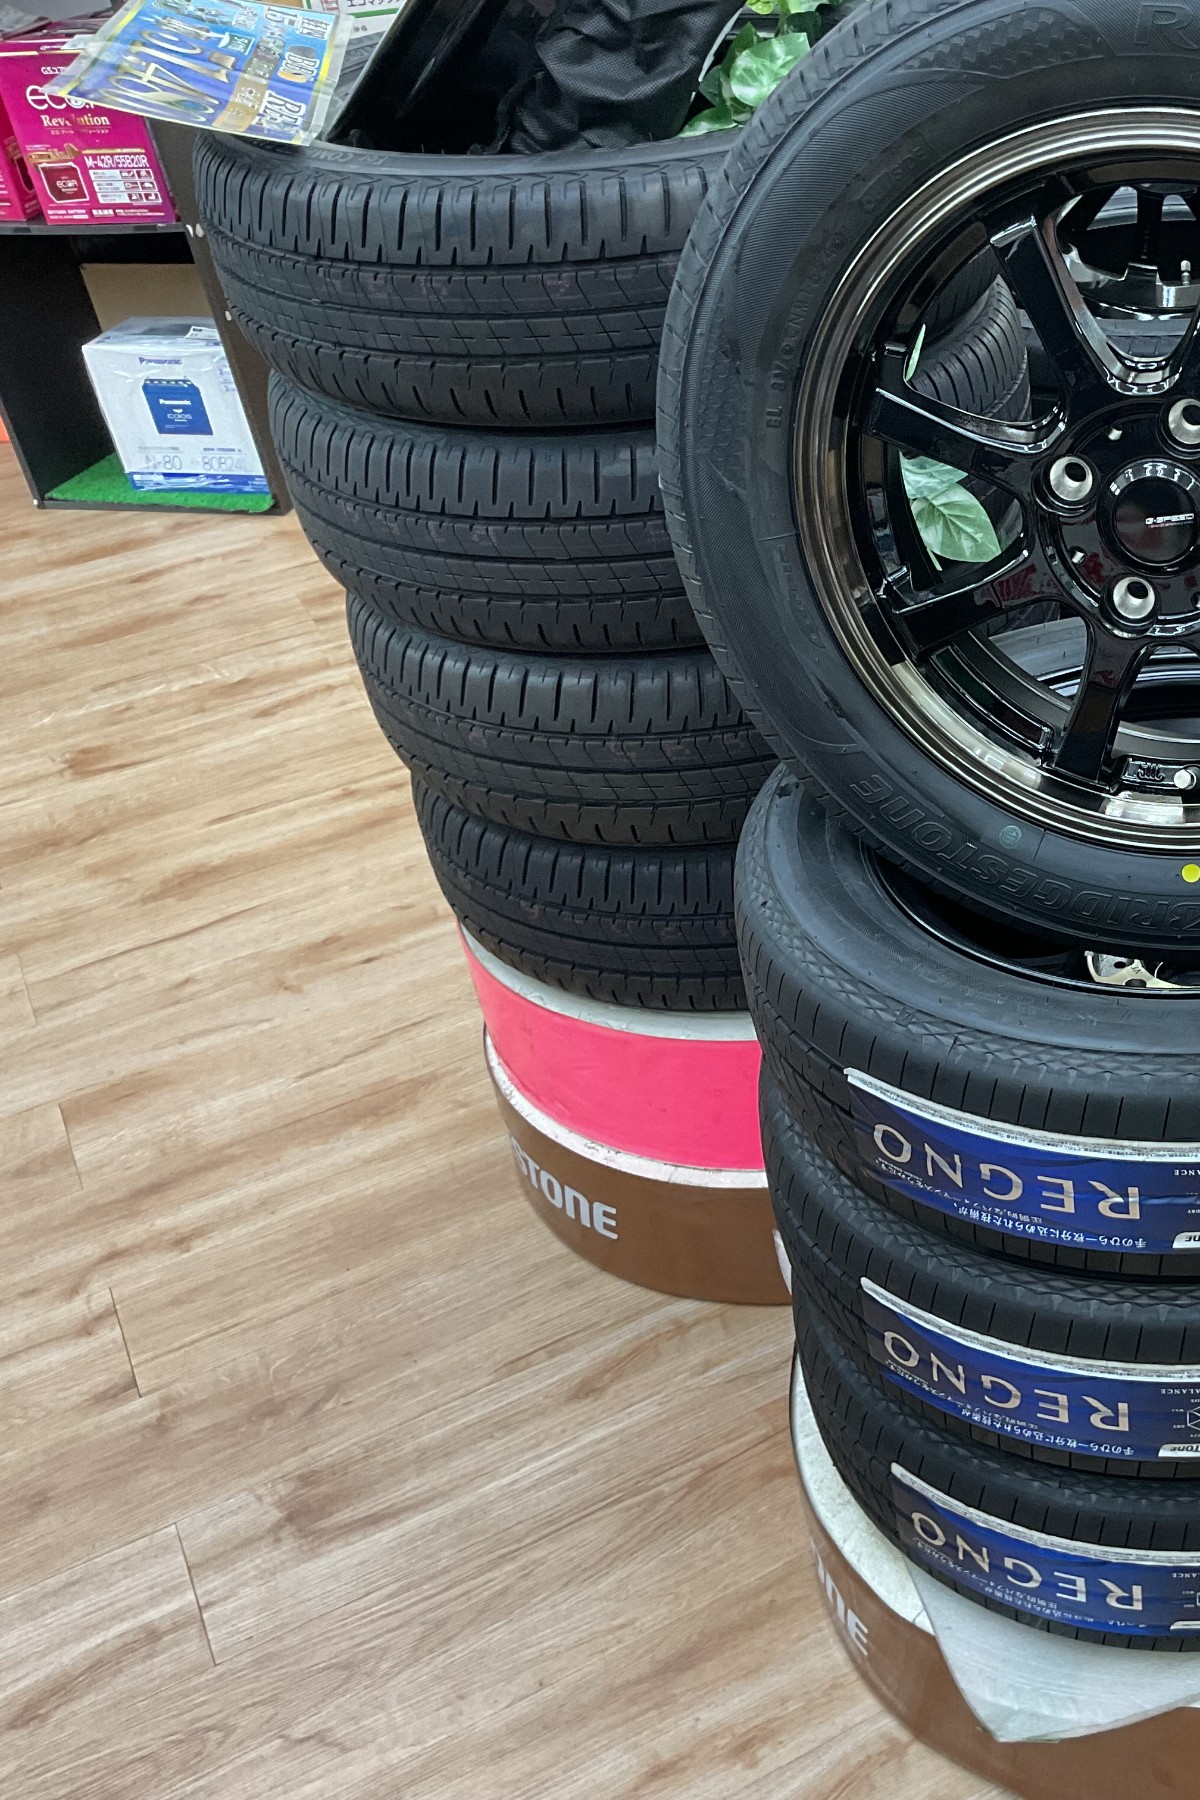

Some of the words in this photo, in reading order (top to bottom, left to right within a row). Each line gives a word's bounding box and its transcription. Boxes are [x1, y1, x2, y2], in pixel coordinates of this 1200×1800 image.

[40, 114, 110, 127] Revution
[84, 154, 150, 169] M-42R/55B20R
[873, 1123, 1141, 1220] REGNO
[953, 1201, 1147, 1248] 手のひら一枚分に込められた技術が、
[883, 1330, 1129, 1432] REGNO
[911, 1511, 1142, 1611] REGNO
